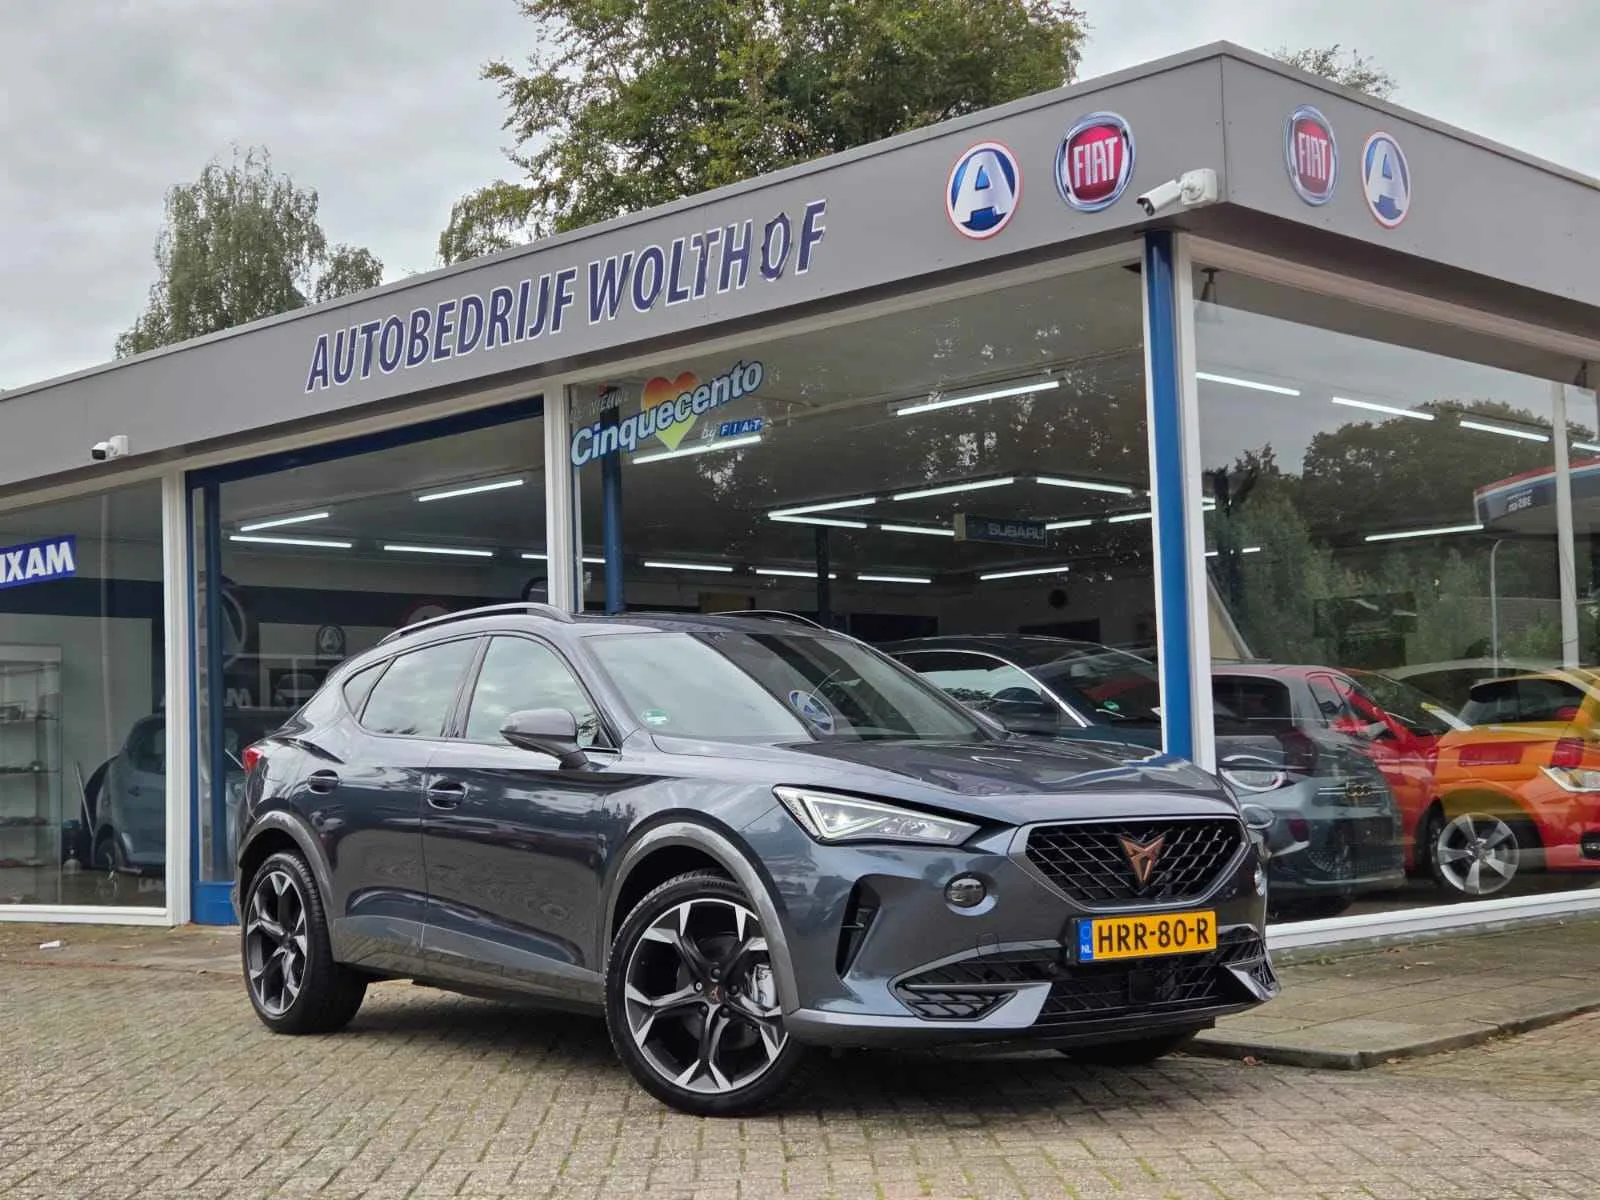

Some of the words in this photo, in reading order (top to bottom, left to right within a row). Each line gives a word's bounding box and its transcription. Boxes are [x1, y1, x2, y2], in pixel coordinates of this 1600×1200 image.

[1072, 136, 1120, 186] FIAT
[1297, 129, 1328, 181] FIAT
[304, 266, 578, 393] AUTOBEDRIJF
[570, 359, 764, 467] Cinquecento
[701, 423, 716, 440] by
[719, 417, 763, 436] FIAT
[987, 523, 1046, 540] SUBARU
[1081, 945, 1092, 953] NL
[1097, 918, 1210, 953] HRR-80-R
